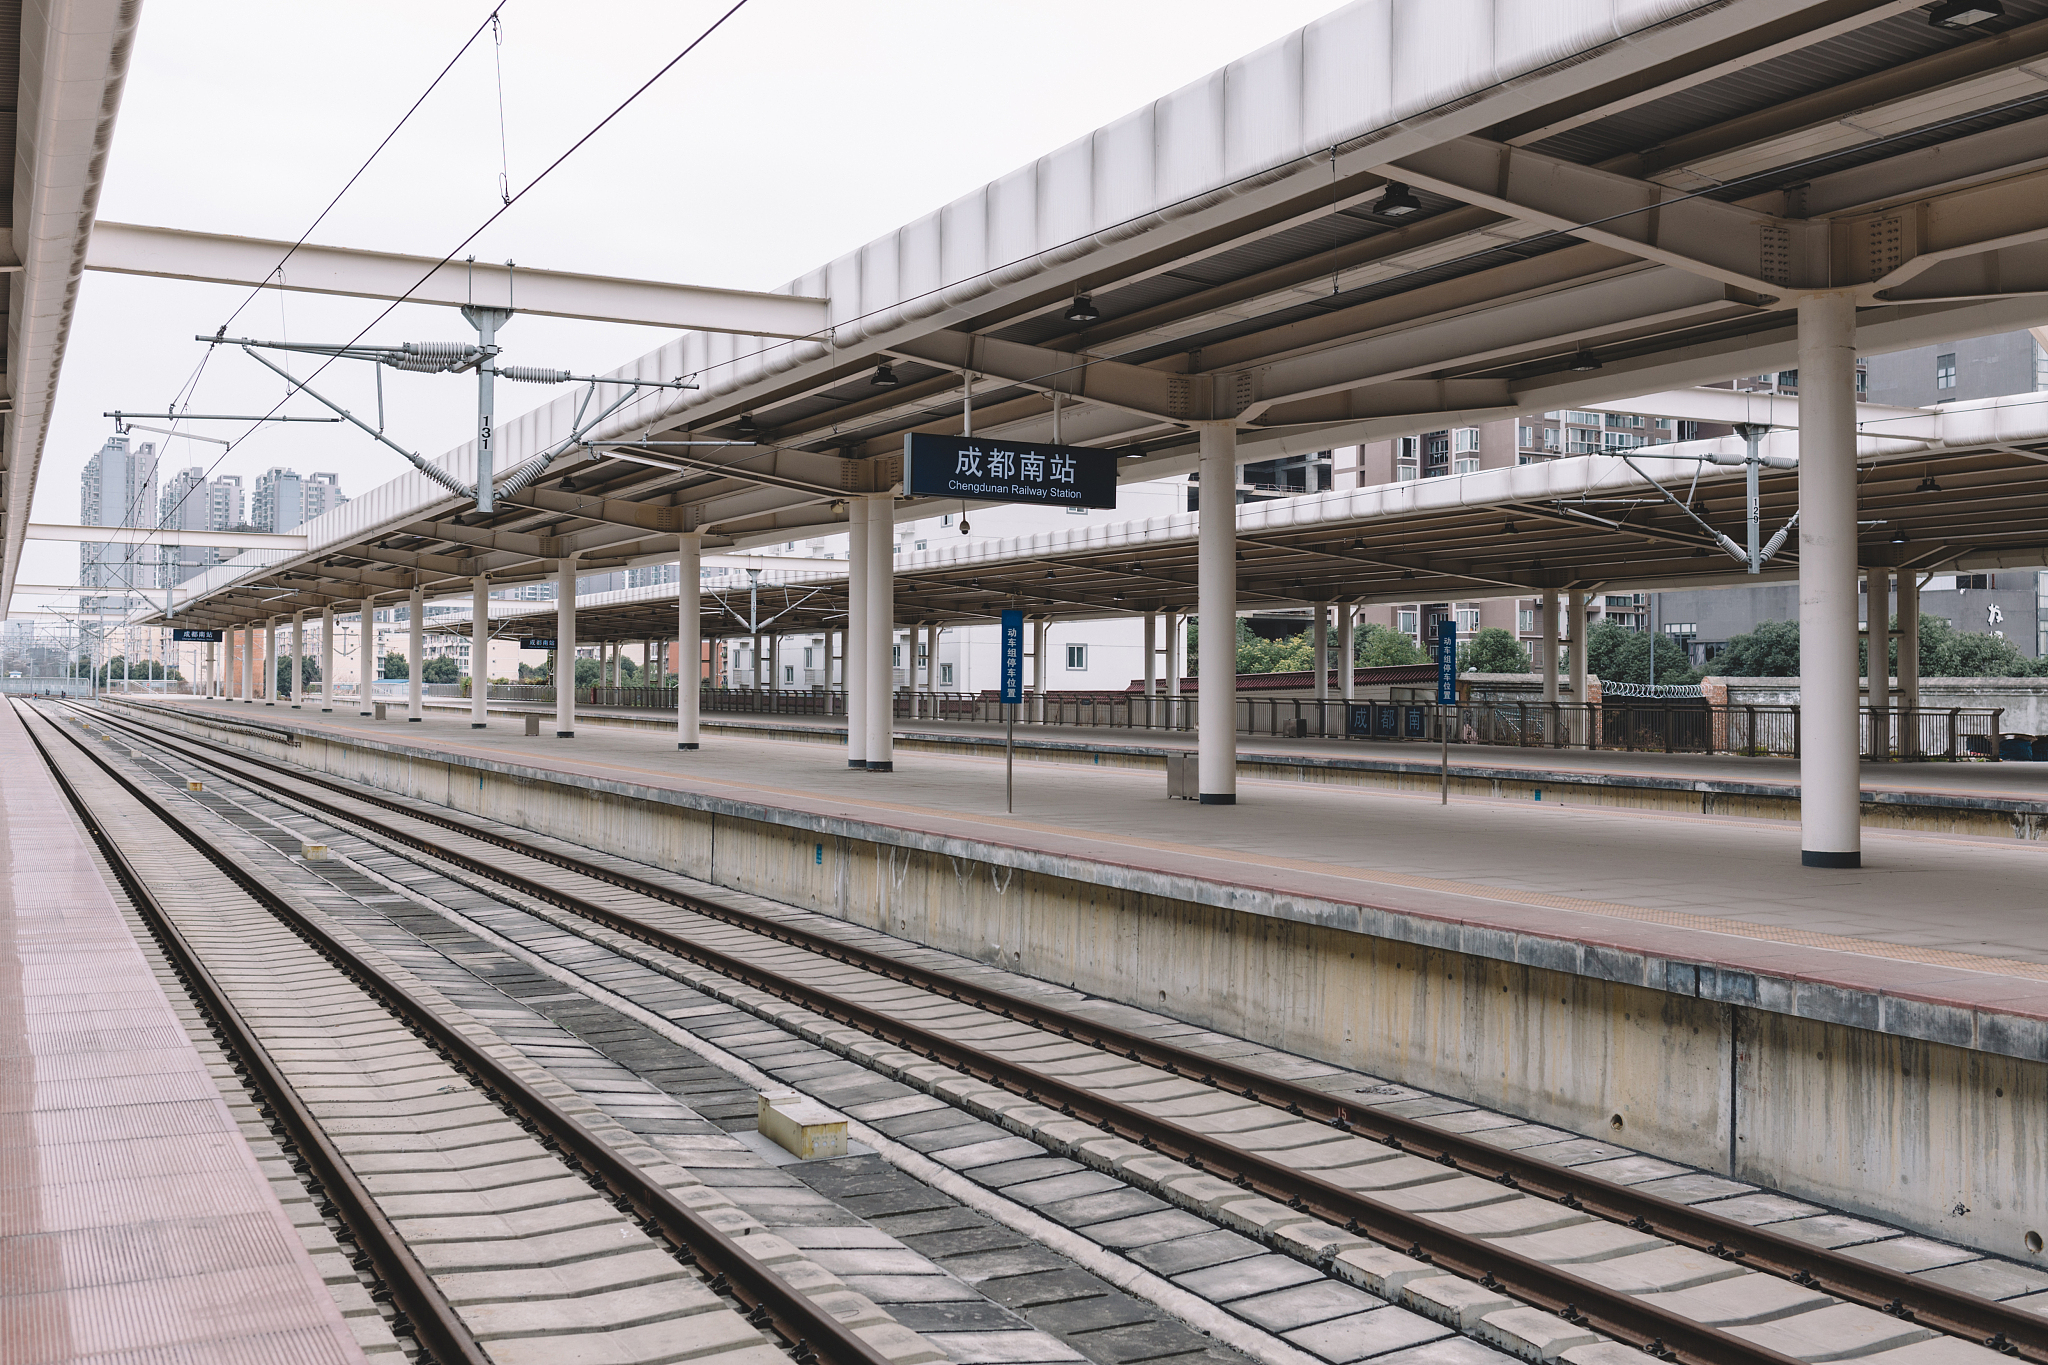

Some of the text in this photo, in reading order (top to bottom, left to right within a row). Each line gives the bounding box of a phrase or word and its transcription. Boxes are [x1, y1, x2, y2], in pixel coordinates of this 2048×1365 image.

[481, 415, 491, 450] 131
[955, 446, 1078, 484] 成都南站
[948, 479, 1082, 499] Chengdunan Railway Station
[1007, 628, 1017, 698] 动车组停车位置
[1443, 637, 1452, 700] 动车组停车位置
[1354, 707, 1420, 731] 成都南
